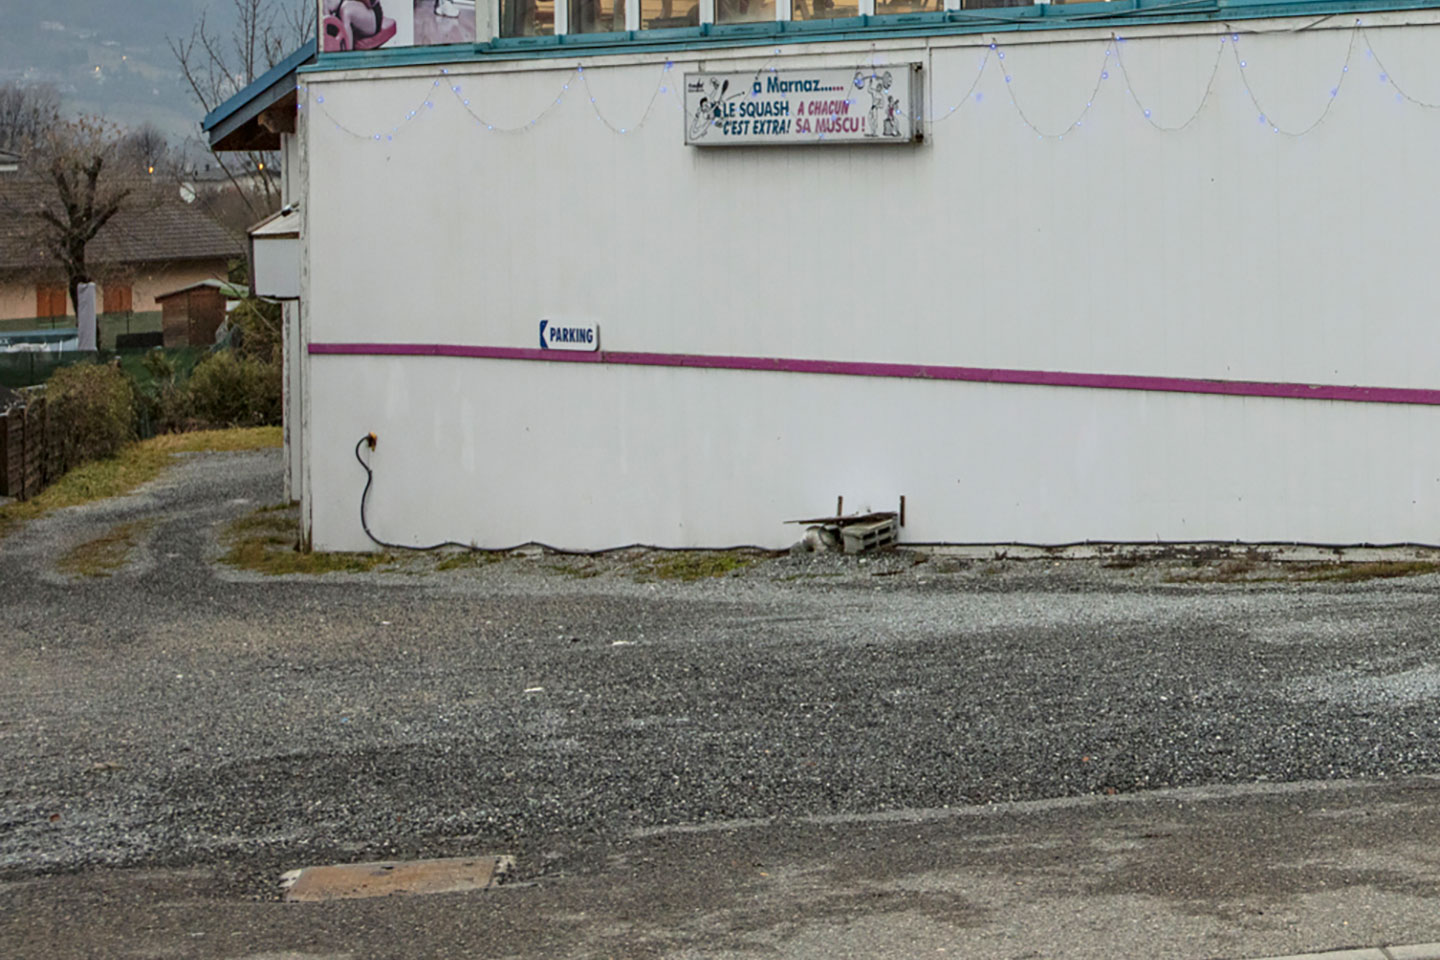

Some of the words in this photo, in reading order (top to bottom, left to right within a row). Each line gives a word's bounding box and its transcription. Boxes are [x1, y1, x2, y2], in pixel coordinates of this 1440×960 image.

[723, 102, 735, 118] LE
[740, 101, 789, 118] SQUASH
[797, 101, 804, 116] A
[808, 100, 849, 116] CHACUN
[723, 120, 749, 135] C'EST
[753, 120, 791, 135] EXTRA!
[795, 118, 811, 134] SA
[550, 327, 593, 344] PARKING
